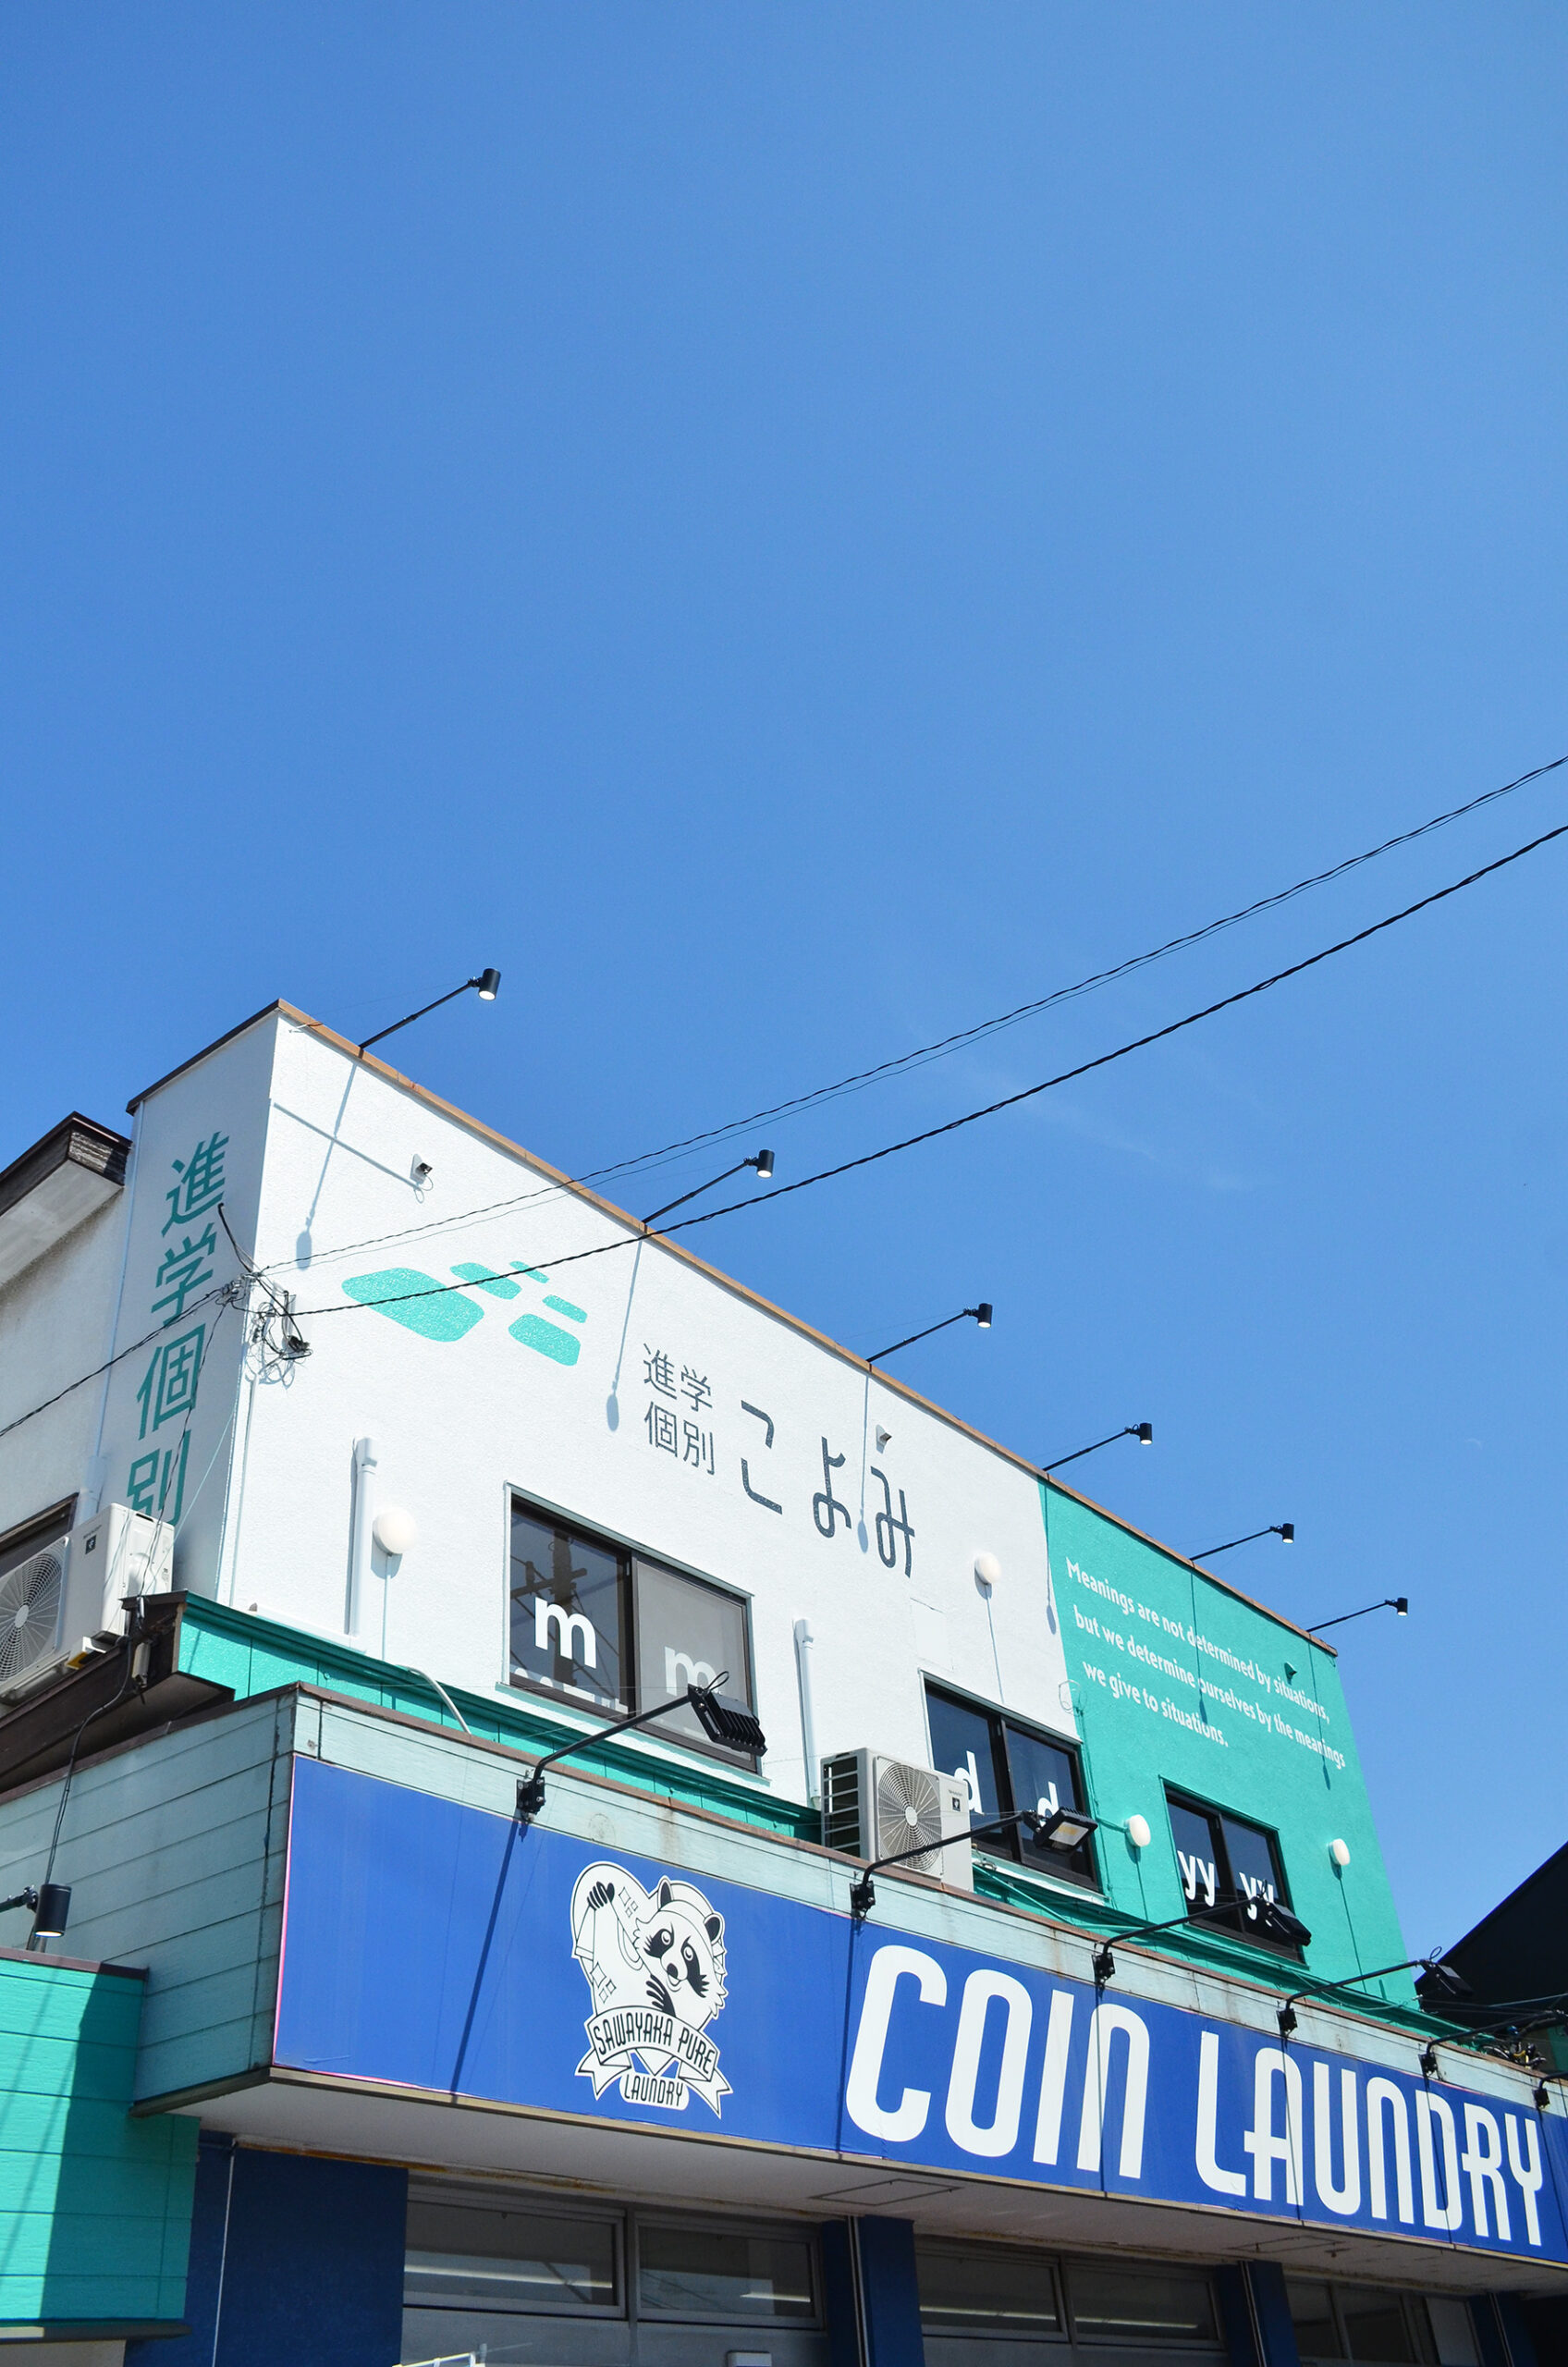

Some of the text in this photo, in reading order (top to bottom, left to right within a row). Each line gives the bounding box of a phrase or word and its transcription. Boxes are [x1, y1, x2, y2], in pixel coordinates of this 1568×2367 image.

[643, 1343, 713, 1412] 進学
[643, 1401, 715, 1476] 個別
[741, 1399, 915, 1578] こよみ
[535, 1597, 596, 1669] m
[1066, 1557, 1329, 1723] Meanings are not determined by situations,
[1074, 1605, 1346, 1770] but we determine ourselves by the meanings
[1083, 1662, 1228, 1747] we give to situations.
[593, 2012, 715, 2075] SAWAYAKA PURE
[624, 2072, 684, 2107] LAUNDRY
[846, 1944, 1543, 2247] COIN LAUNDRY
